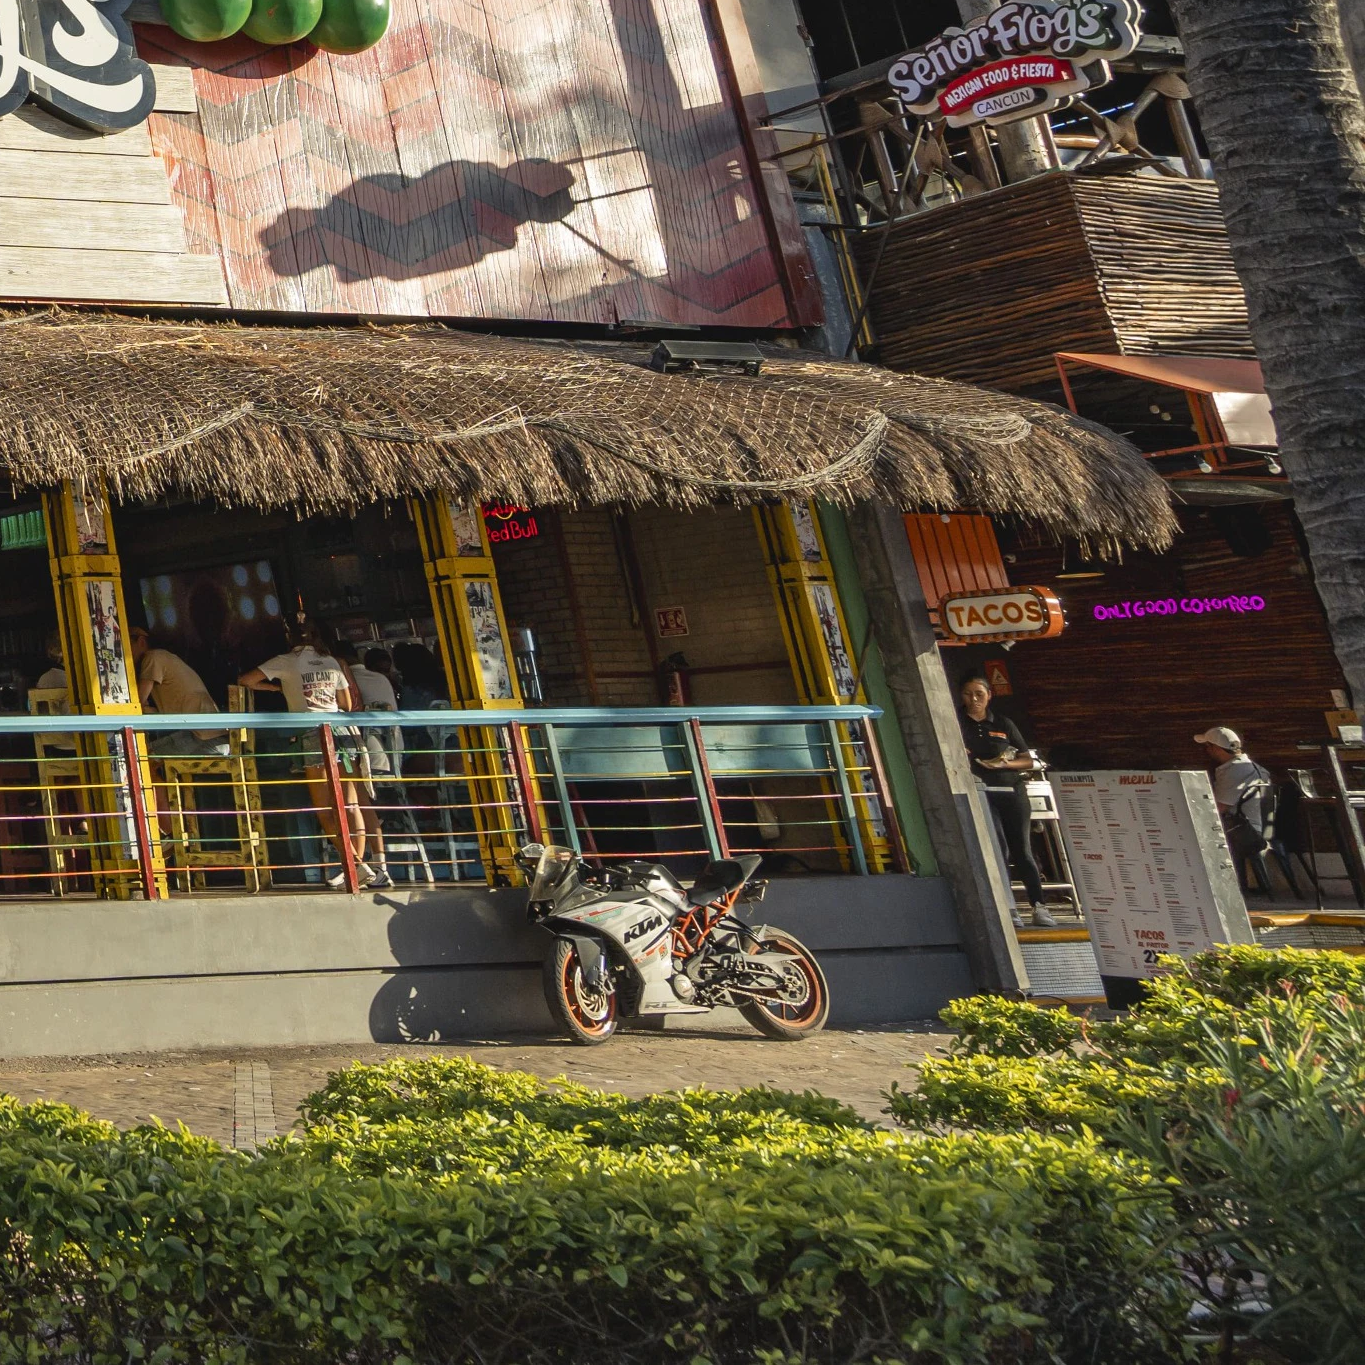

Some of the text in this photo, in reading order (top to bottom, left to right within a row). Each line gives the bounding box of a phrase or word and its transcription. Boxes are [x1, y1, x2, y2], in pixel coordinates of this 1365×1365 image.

[888, 28, 989, 103] Señor
[945, 62, 1055, 108] MEXICAN FOOD & FIESTA
[976, 88, 1032, 116] CANCÚN
[509, 516, 539, 540] Bull
[947, 598, 1043, 629] TACOS
[301, 672, 315, 683] YOU
[1119, 771, 1158, 786] menú
[623, 913, 664, 945] KTM
[1133, 929, 1166, 941] TACOS
